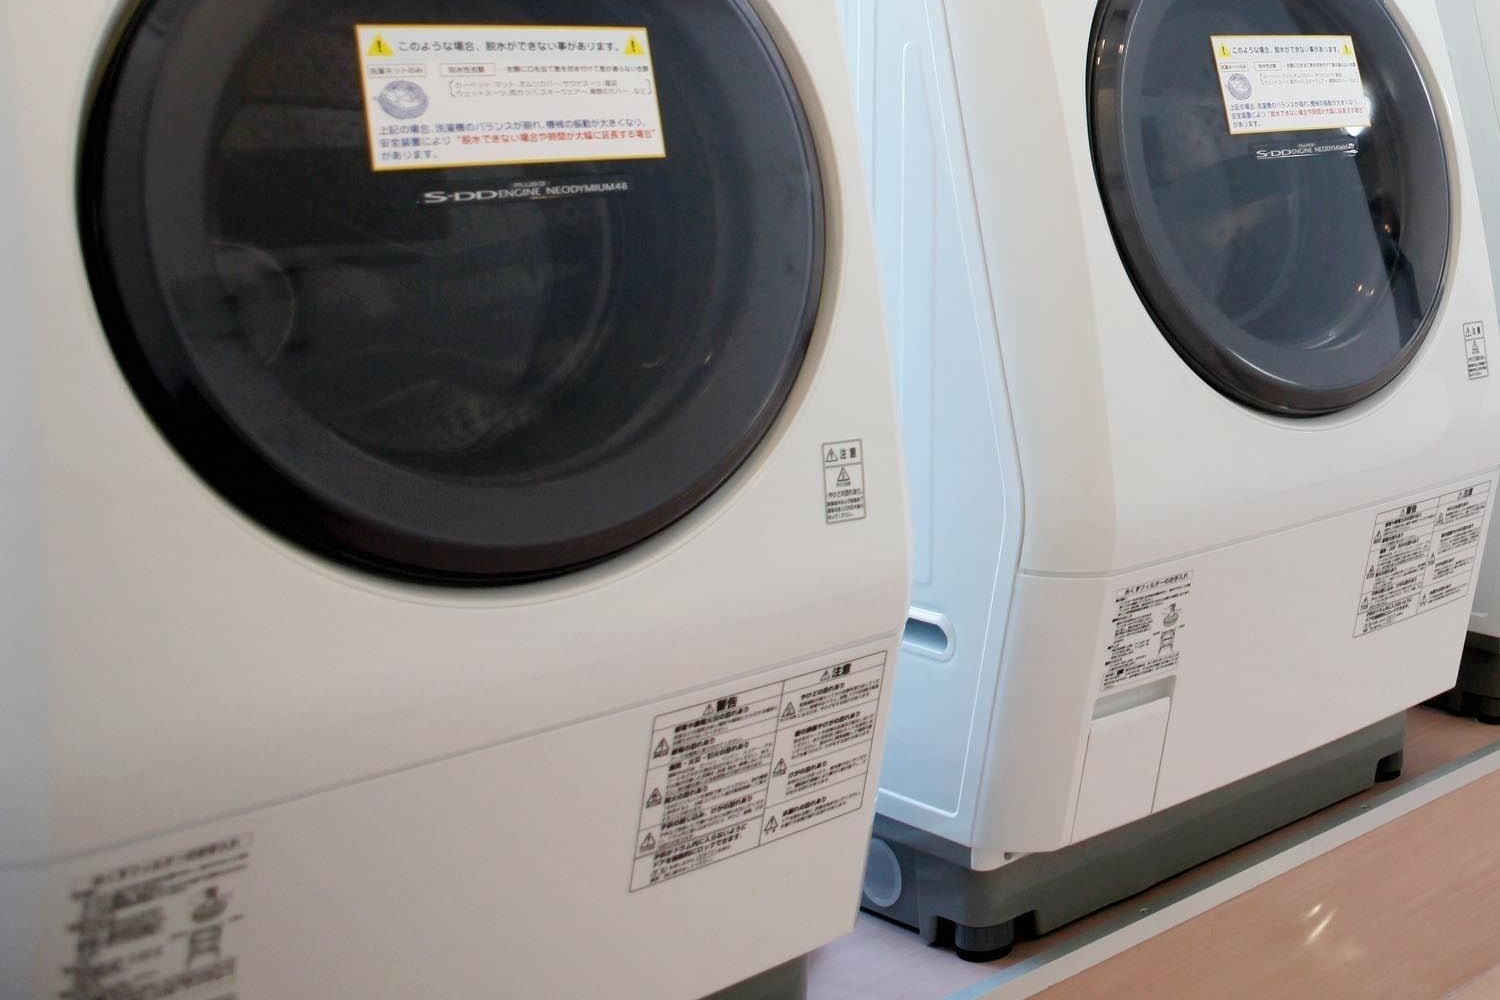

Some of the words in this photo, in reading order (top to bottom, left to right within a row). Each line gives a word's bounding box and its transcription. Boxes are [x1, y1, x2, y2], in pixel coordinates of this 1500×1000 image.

[381, 150, 439, 161] があります。
[498, 187, 541, 198] ENGINE
